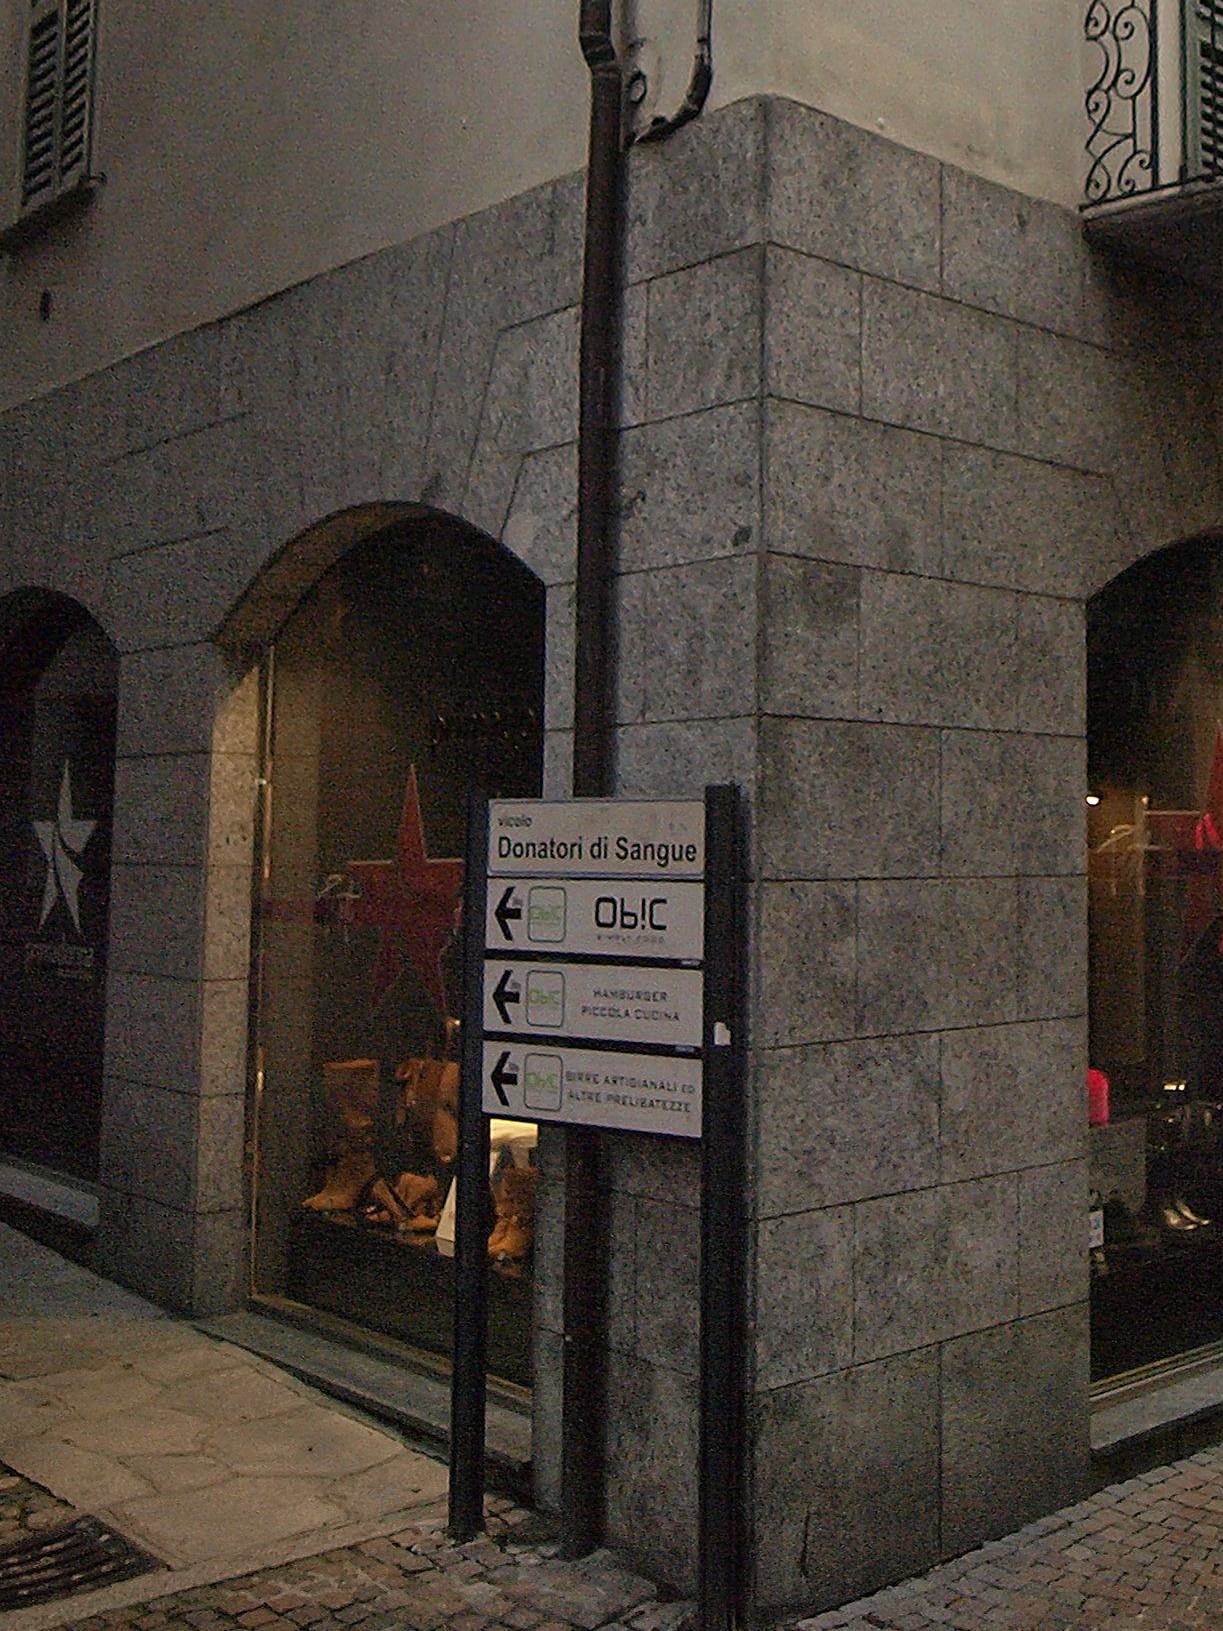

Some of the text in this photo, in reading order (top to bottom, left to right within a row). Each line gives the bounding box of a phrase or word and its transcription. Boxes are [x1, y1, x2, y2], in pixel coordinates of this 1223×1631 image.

[499, 836, 697, 867] Donatori di Sangue
[592, 988, 668, 1003] HAMBURGER
